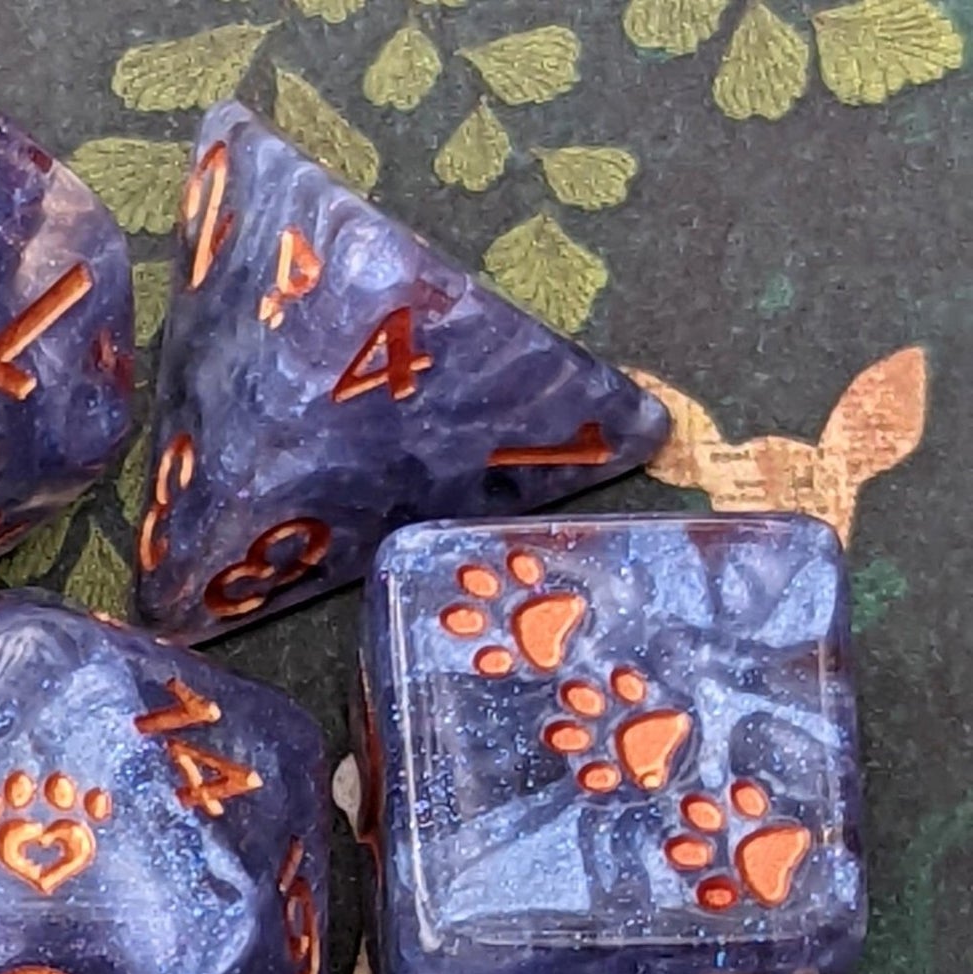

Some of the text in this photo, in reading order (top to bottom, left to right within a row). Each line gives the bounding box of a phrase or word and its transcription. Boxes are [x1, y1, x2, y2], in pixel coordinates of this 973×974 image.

[332, 306, 434, 403] 4
[488, 421, 614, 467] 1
[134, 677, 265, 818] 14
